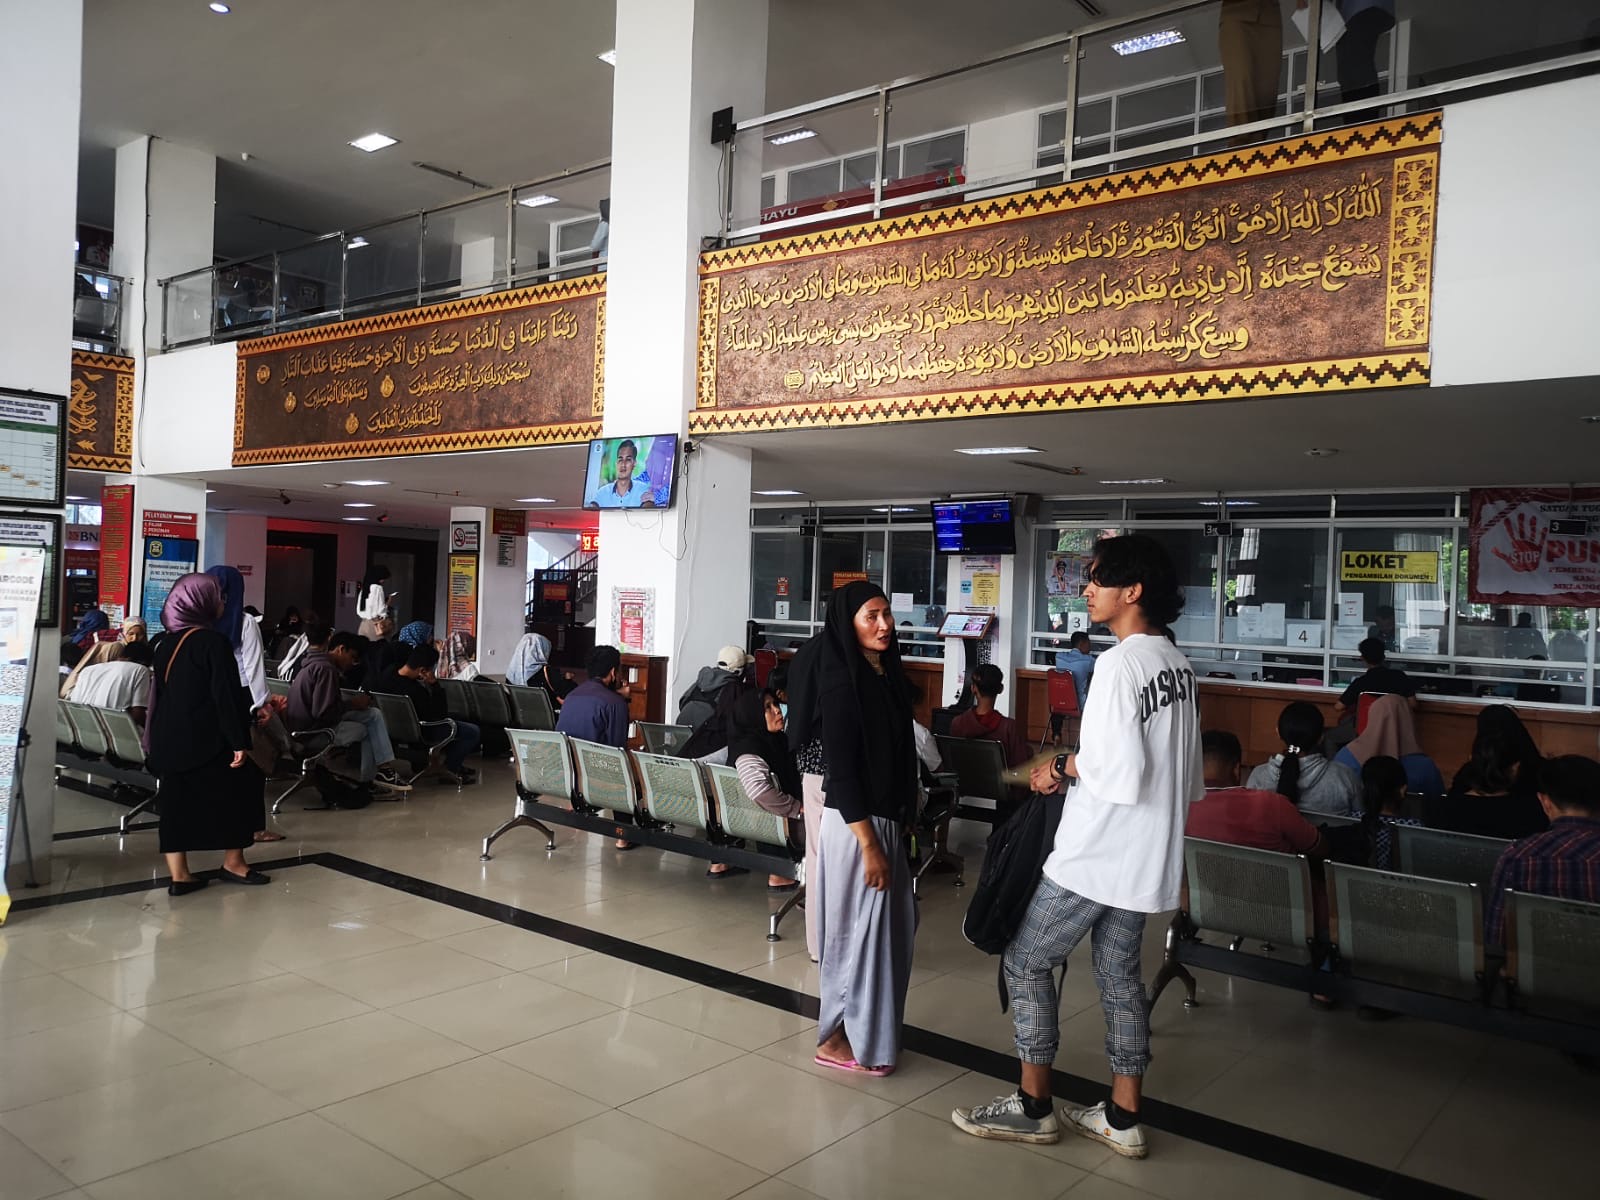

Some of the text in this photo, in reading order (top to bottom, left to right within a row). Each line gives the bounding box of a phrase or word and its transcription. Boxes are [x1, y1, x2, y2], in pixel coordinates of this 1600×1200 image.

[1345, 554, 1407, 569] LOKET
[1511, 551, 1540, 564] STOP
[1073, 616, 1081, 628] 3
[1298, 630, 1308, 643] 4
